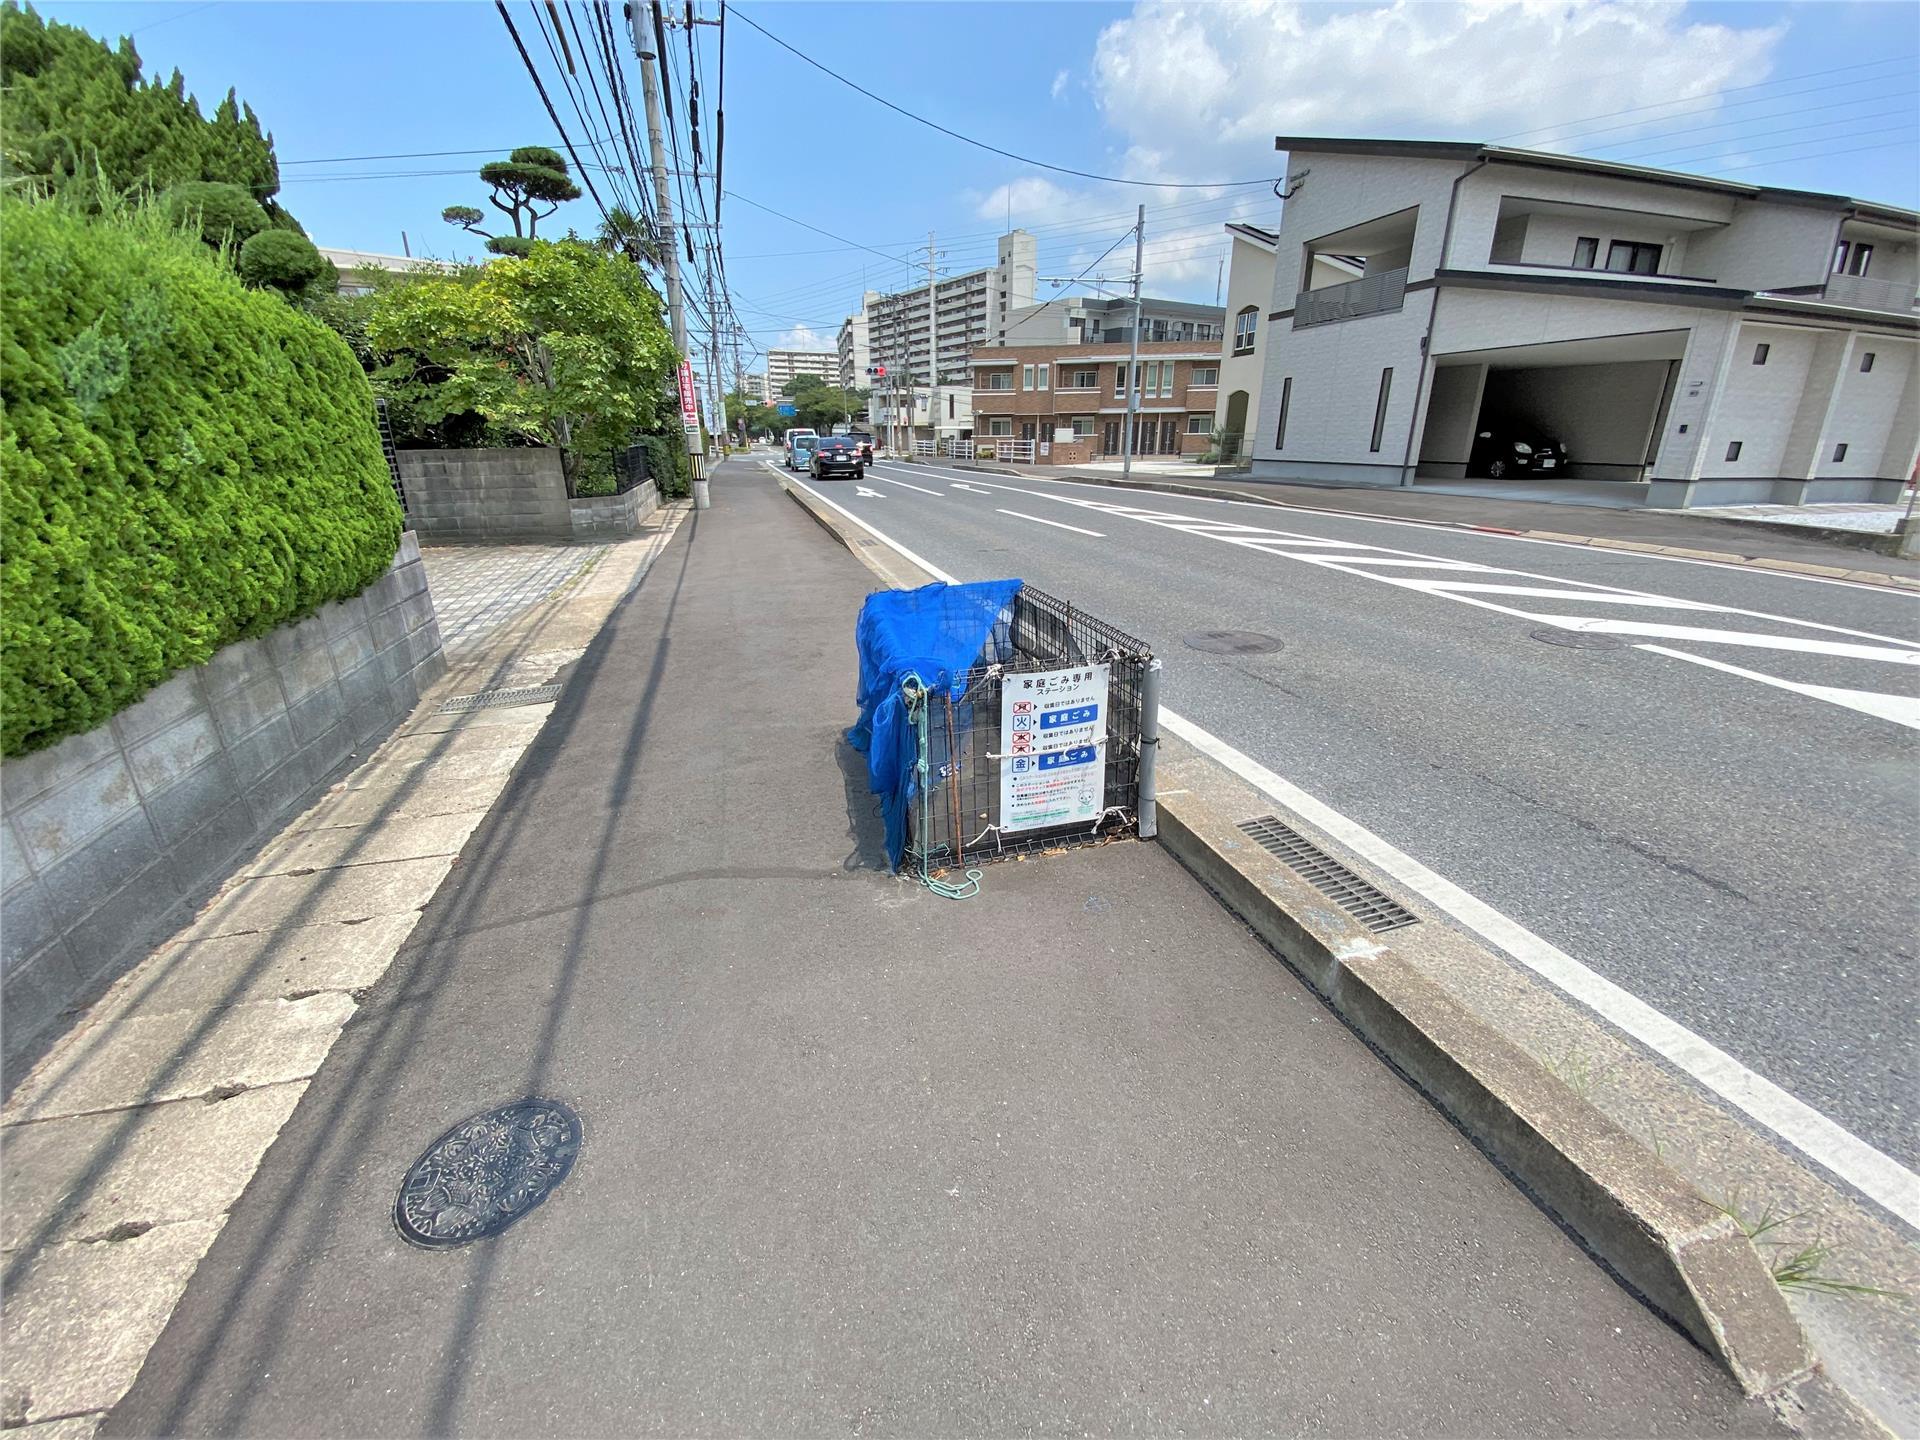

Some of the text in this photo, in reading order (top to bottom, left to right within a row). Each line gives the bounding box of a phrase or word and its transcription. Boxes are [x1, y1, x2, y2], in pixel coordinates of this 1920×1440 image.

[1023, 672, 1093, 689] 家庭ごみ専用
[1036, 684, 1080, 696] ステーション
[1016, 716, 1027, 728] 火
[1048, 709, 1091, 724] 家庭ごみ
[1015, 758, 1026, 769] 金
